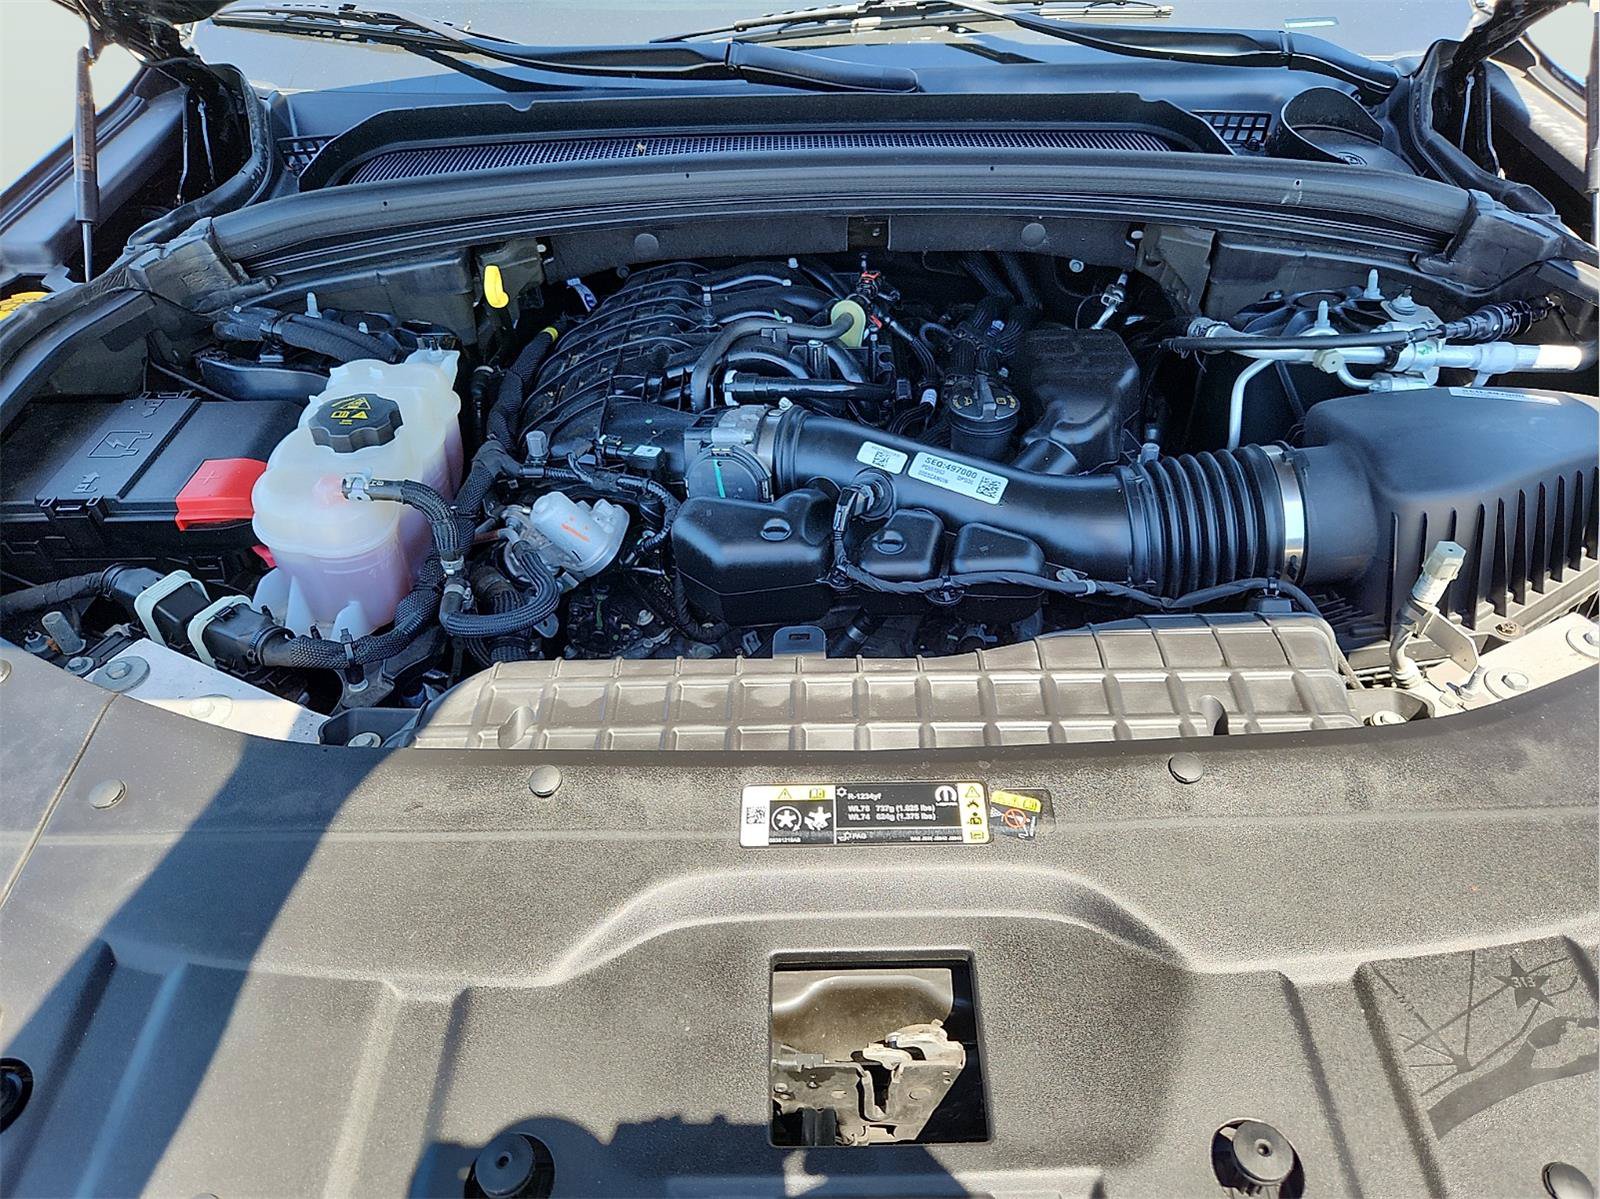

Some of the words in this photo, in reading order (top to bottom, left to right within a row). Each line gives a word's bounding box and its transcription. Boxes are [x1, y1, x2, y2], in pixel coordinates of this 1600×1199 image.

[925, 456, 978, 479] SEQ:497000
[920, 803, 936, 813] lbs)
[921, 812, 936, 821] lbs)
[1511, 976, 1536, 988] 313
